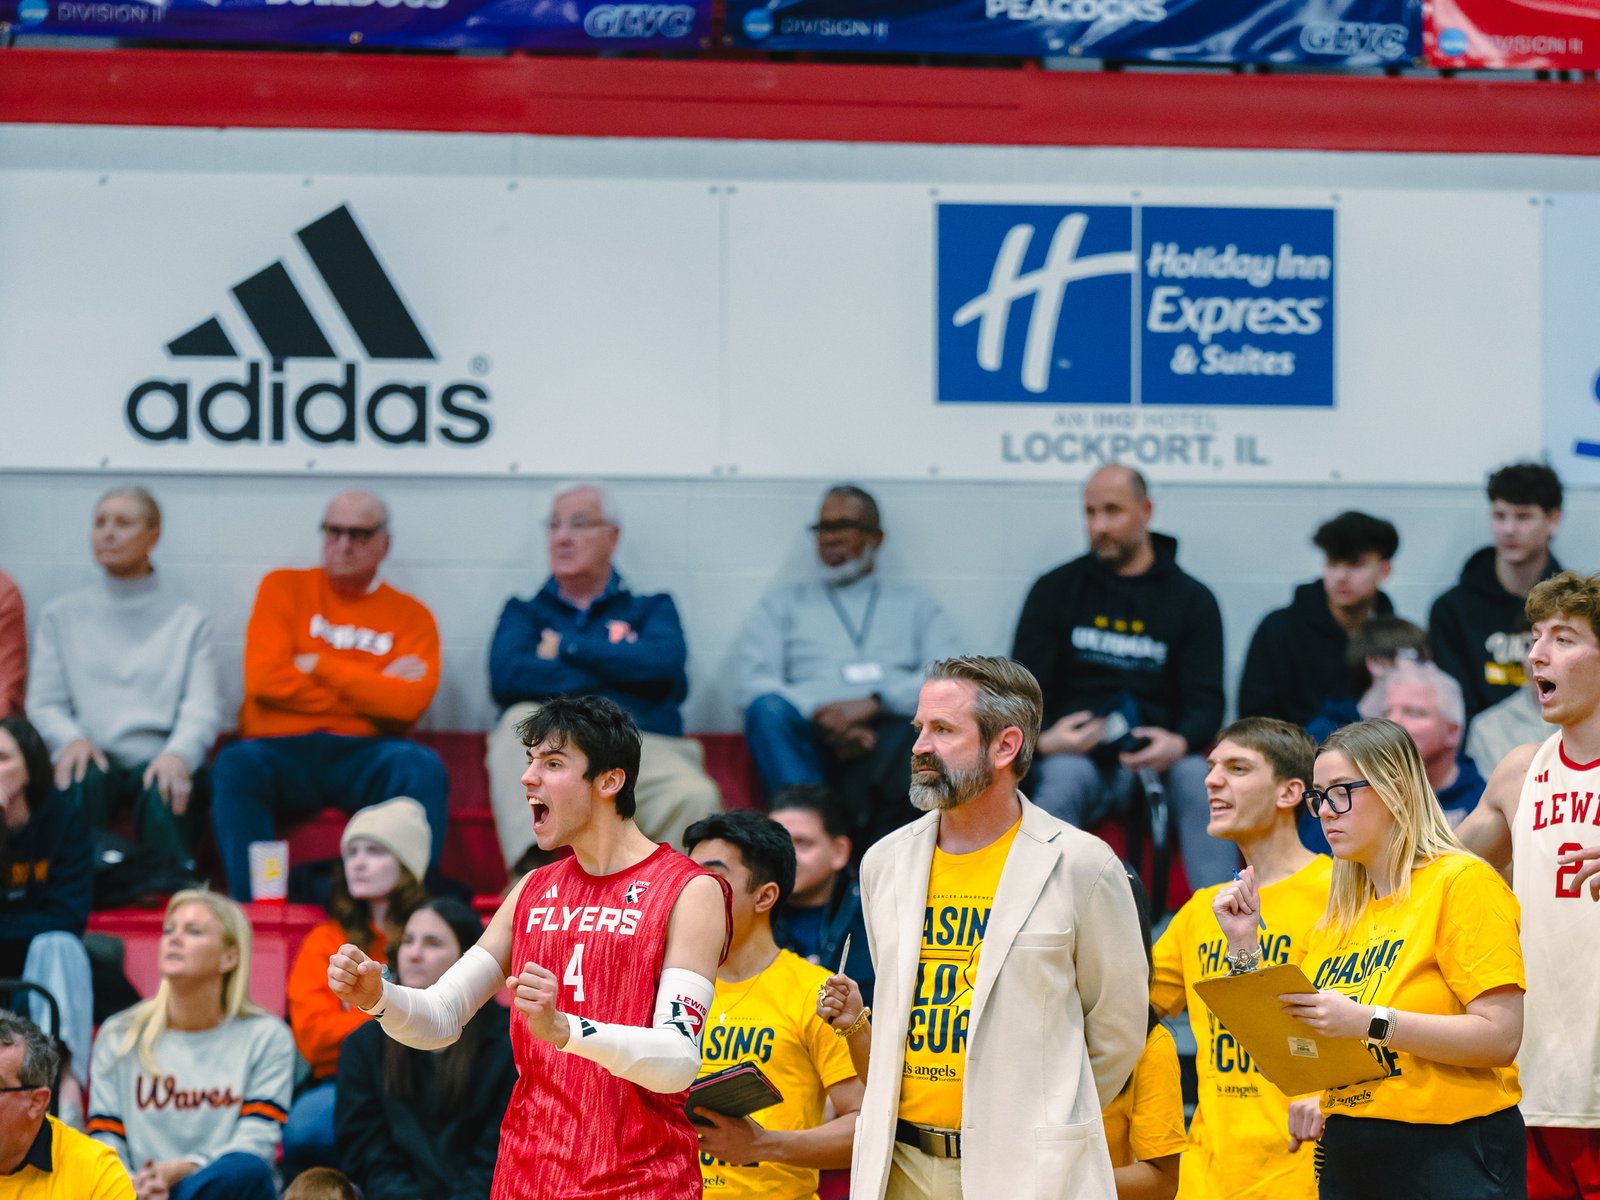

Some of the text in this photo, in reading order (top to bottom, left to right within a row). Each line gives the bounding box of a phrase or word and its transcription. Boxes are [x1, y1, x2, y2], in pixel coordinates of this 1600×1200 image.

[57, 4, 147, 22] DIVISION
[1146, 242, 1331, 287] Holiday Inn
[1147, 286, 1325, 344] Express
[1170, 343, 1296, 376] & Suites
[127, 362, 490, 444] adidas
[1001, 433, 1269, 467] LOCKPORT, IL
[525, 906, 643, 936] FLYERS
[922, 906, 992, 947] ASIN
[563, 943, 585, 1002] 4
[1313, 939, 1405, 991] CHASING
[676, 994, 708, 1017] LEWIS
[699, 1025, 775, 1064] SING
[908, 1008, 971, 1054] CUR
[914, 1064, 956, 1082] angels
[1224, 1083, 1259, 1099] angels
[137, 1076, 240, 1112] Waves
